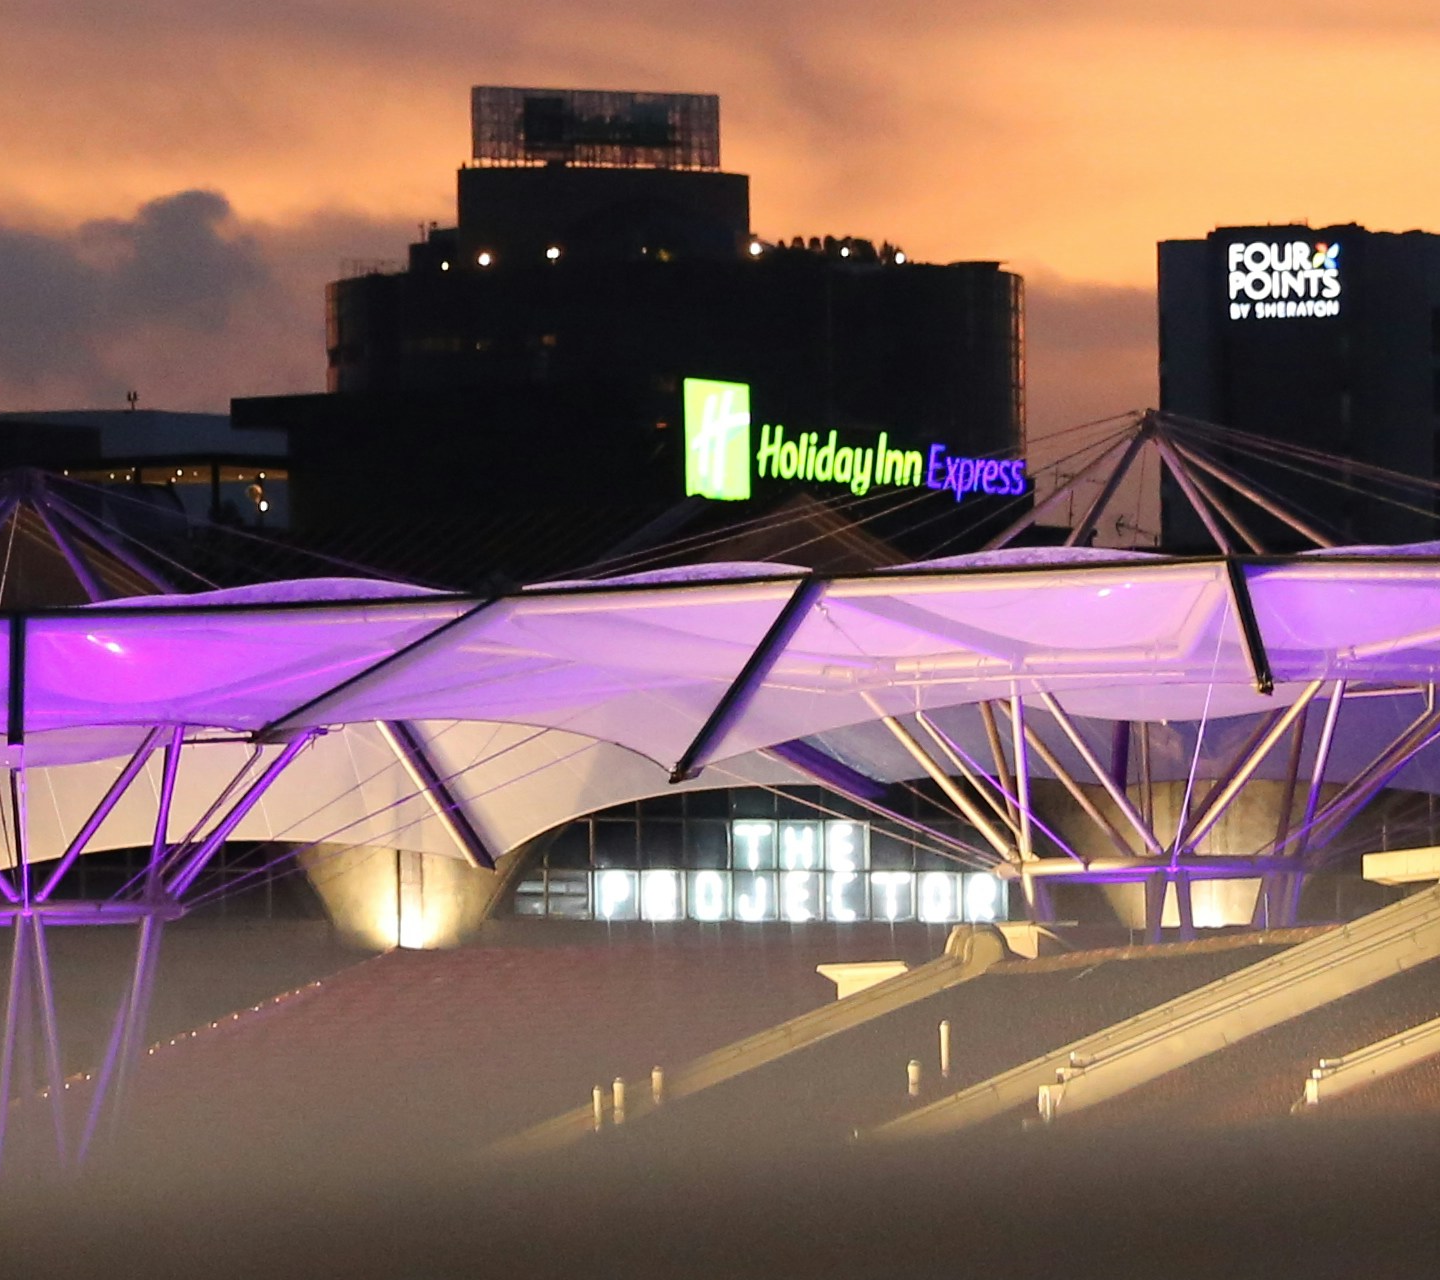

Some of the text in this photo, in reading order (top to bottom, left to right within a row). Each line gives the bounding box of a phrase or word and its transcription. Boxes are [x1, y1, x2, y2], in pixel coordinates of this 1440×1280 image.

[1229, 241, 1312, 271] FOUR
[1229, 268, 1341, 300] POINTS
[1230, 300, 1340, 320] BY SHERATON
[756, 424, 1026, 503] Holiday Inn Express
[733, 823, 855, 871] THE
[600, 869, 996, 921] PROJECTOR
